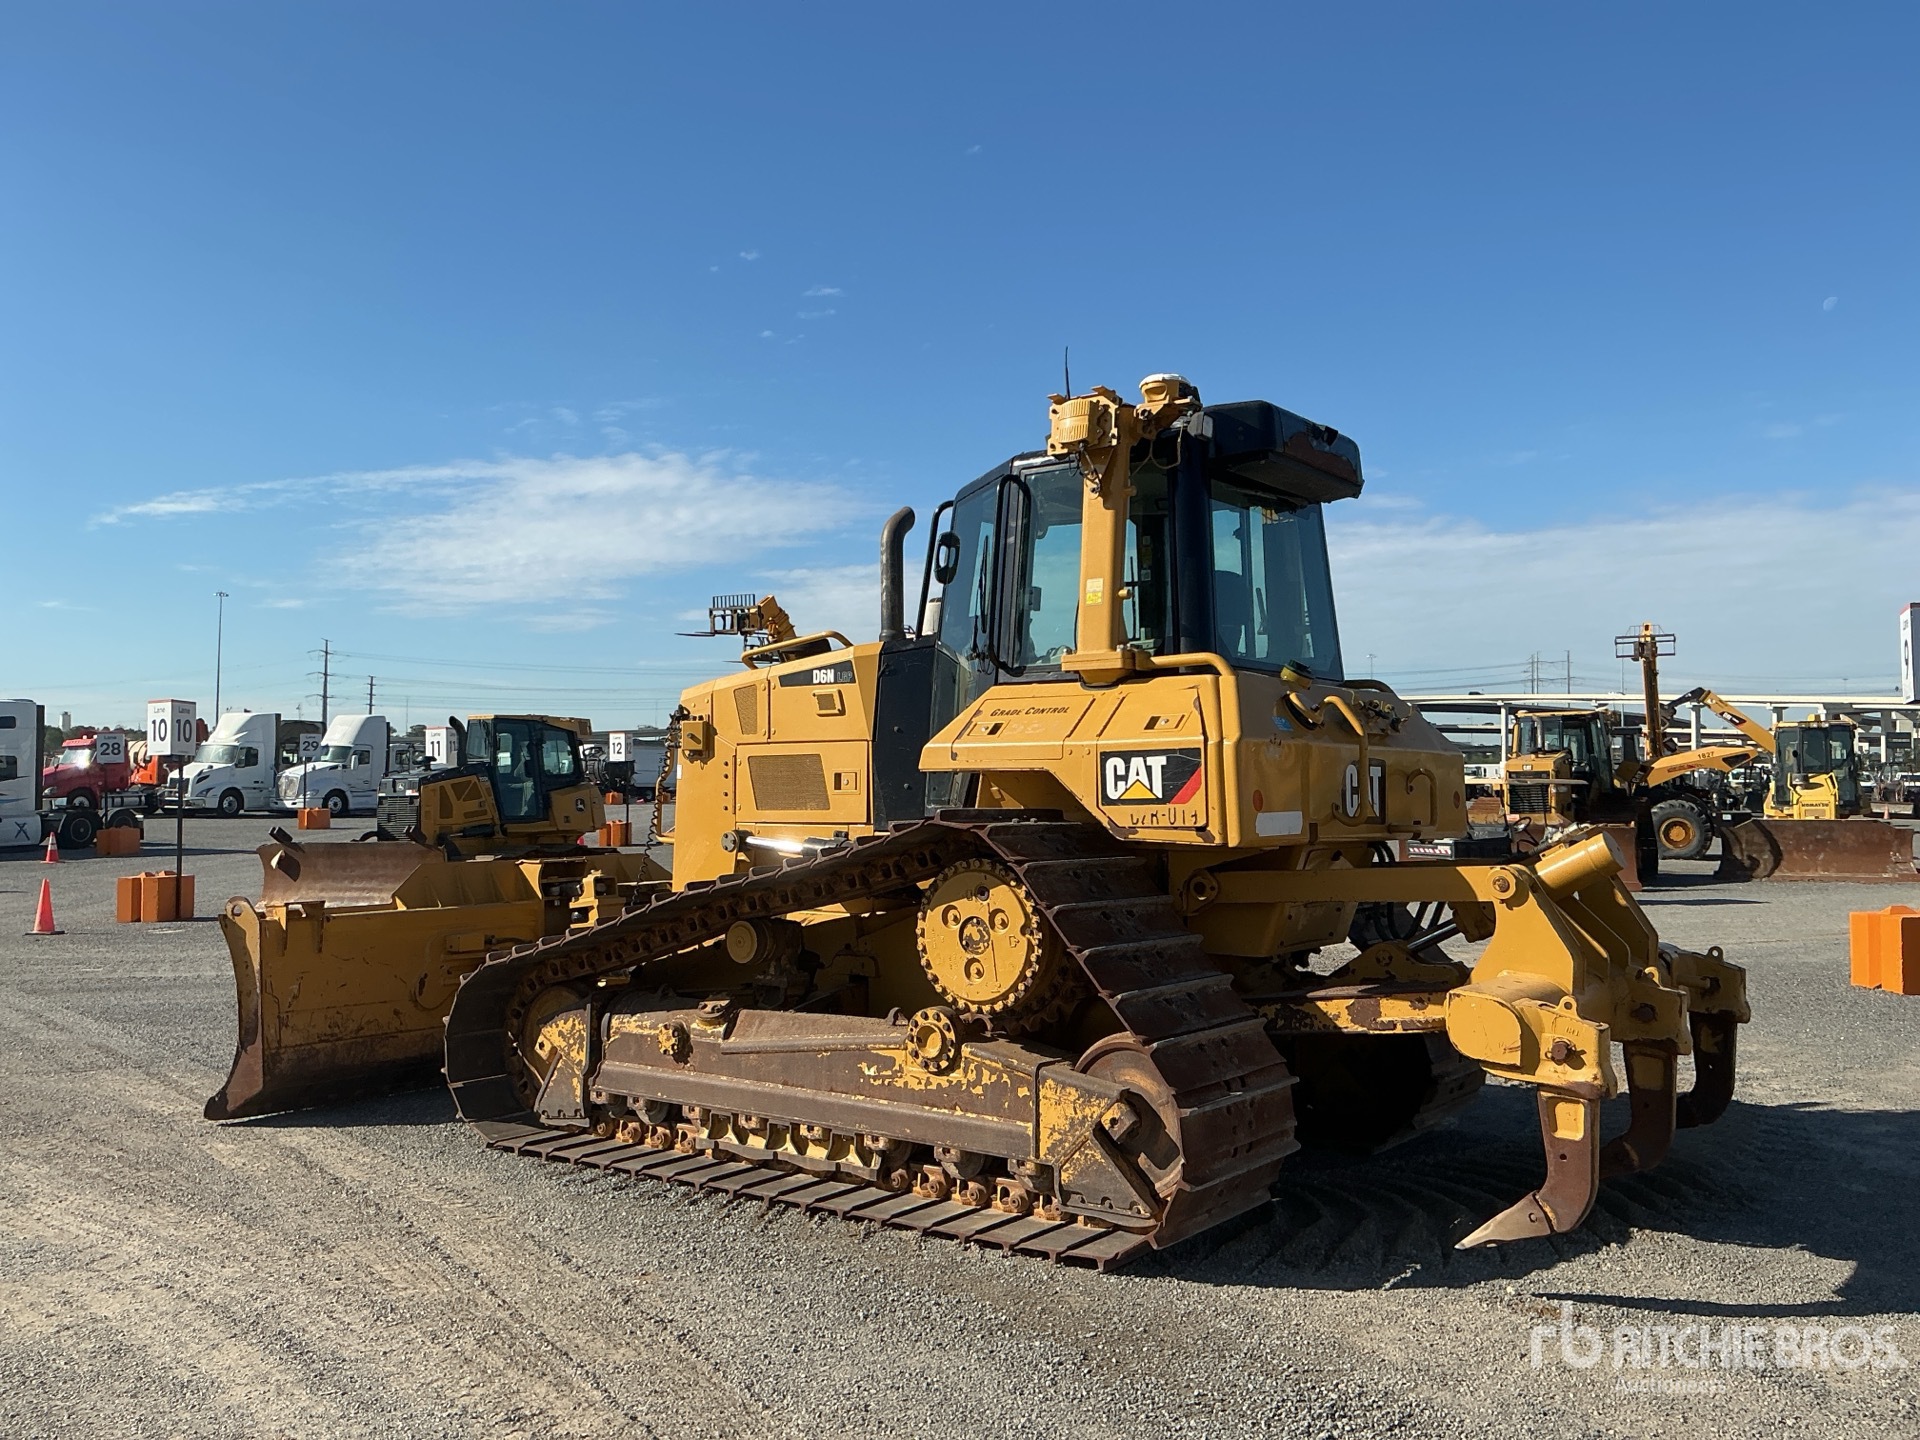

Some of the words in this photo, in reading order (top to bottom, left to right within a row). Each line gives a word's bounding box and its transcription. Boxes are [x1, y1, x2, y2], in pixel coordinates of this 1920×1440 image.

[1904, 639, 1909, 680] 9
[812, 668, 835, 684] D6N
[153, 706, 166, 714] Lane
[151, 718, 167, 742] 10
[176, 718, 192, 743] 10
[100, 742, 121, 756] 28
[302, 740, 320, 752] 29
[430, 740, 441, 757] 11
[611, 742, 622, 755] 12
[1105, 755, 1167, 800] CAT
[1345, 764, 1382, 817] CT
